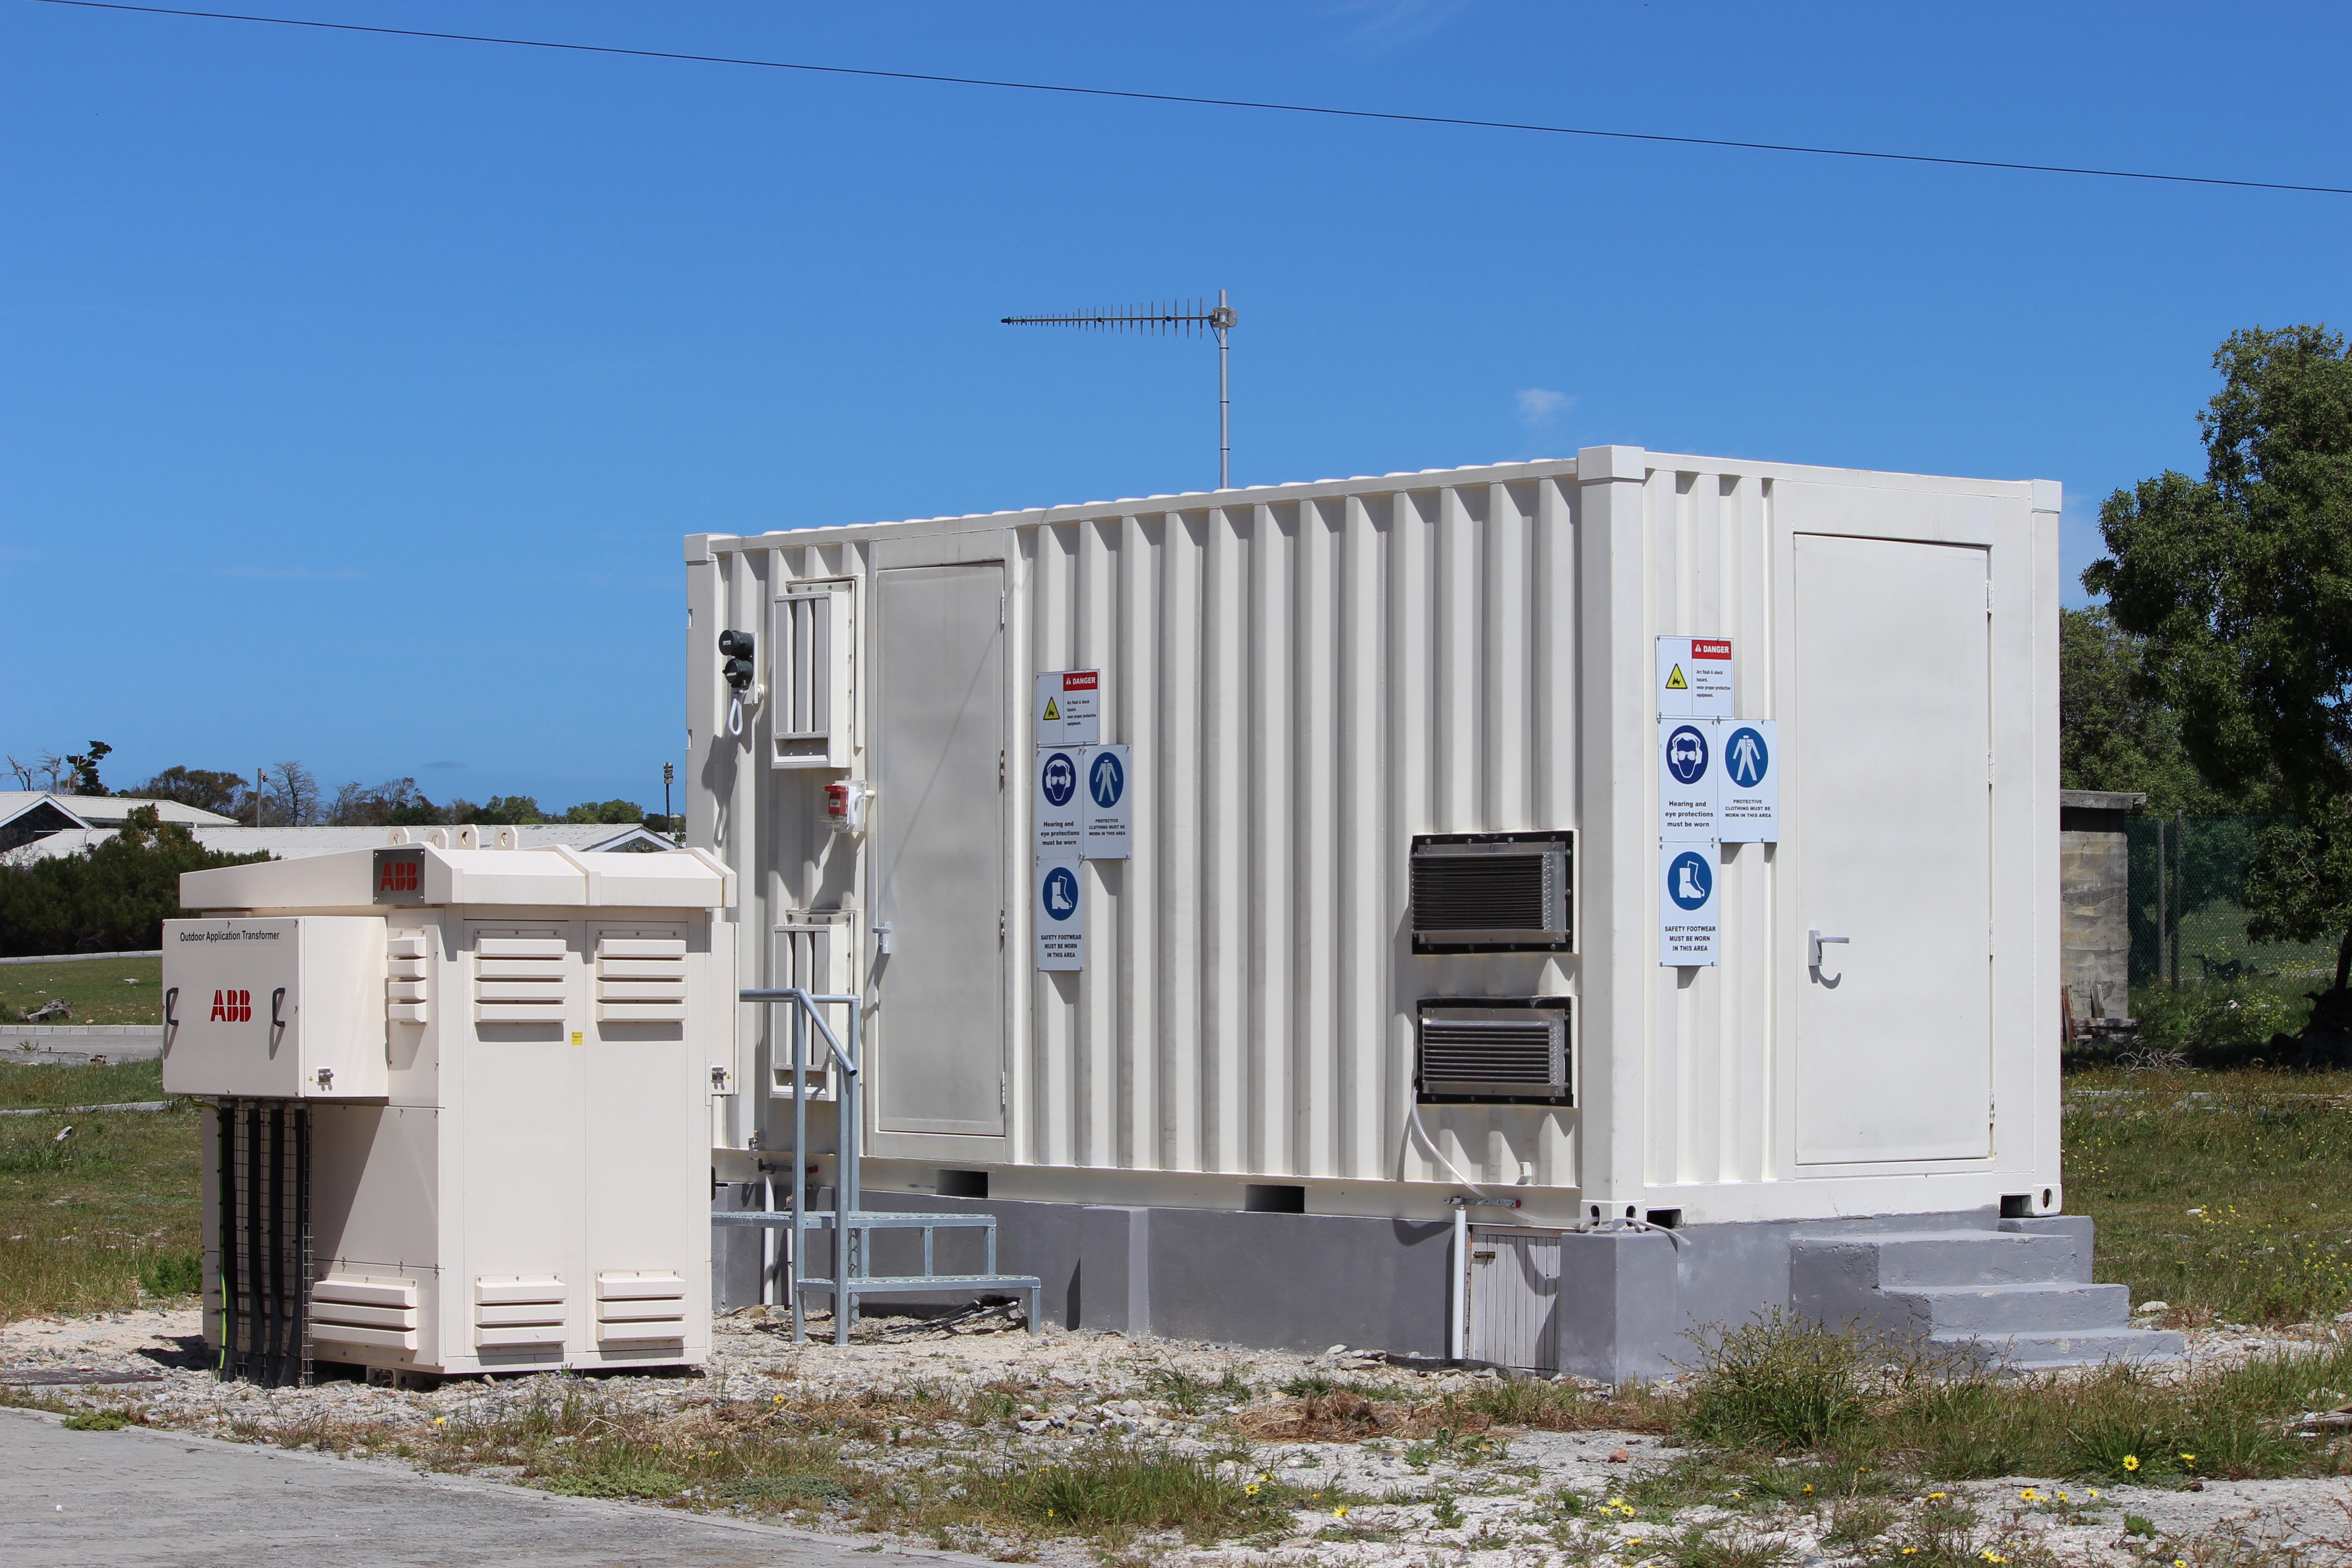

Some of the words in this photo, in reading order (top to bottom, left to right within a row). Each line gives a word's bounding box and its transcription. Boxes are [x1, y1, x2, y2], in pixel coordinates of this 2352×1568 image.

[1703, 645, 1729, 653] DANGER
[380, 862, 417, 891] ABB
[180, 931, 205, 942] Outdoor
[206, 931, 240, 943] Application
[242, 930, 279, 940] Transformer
[211, 990, 251, 1022] ABB
